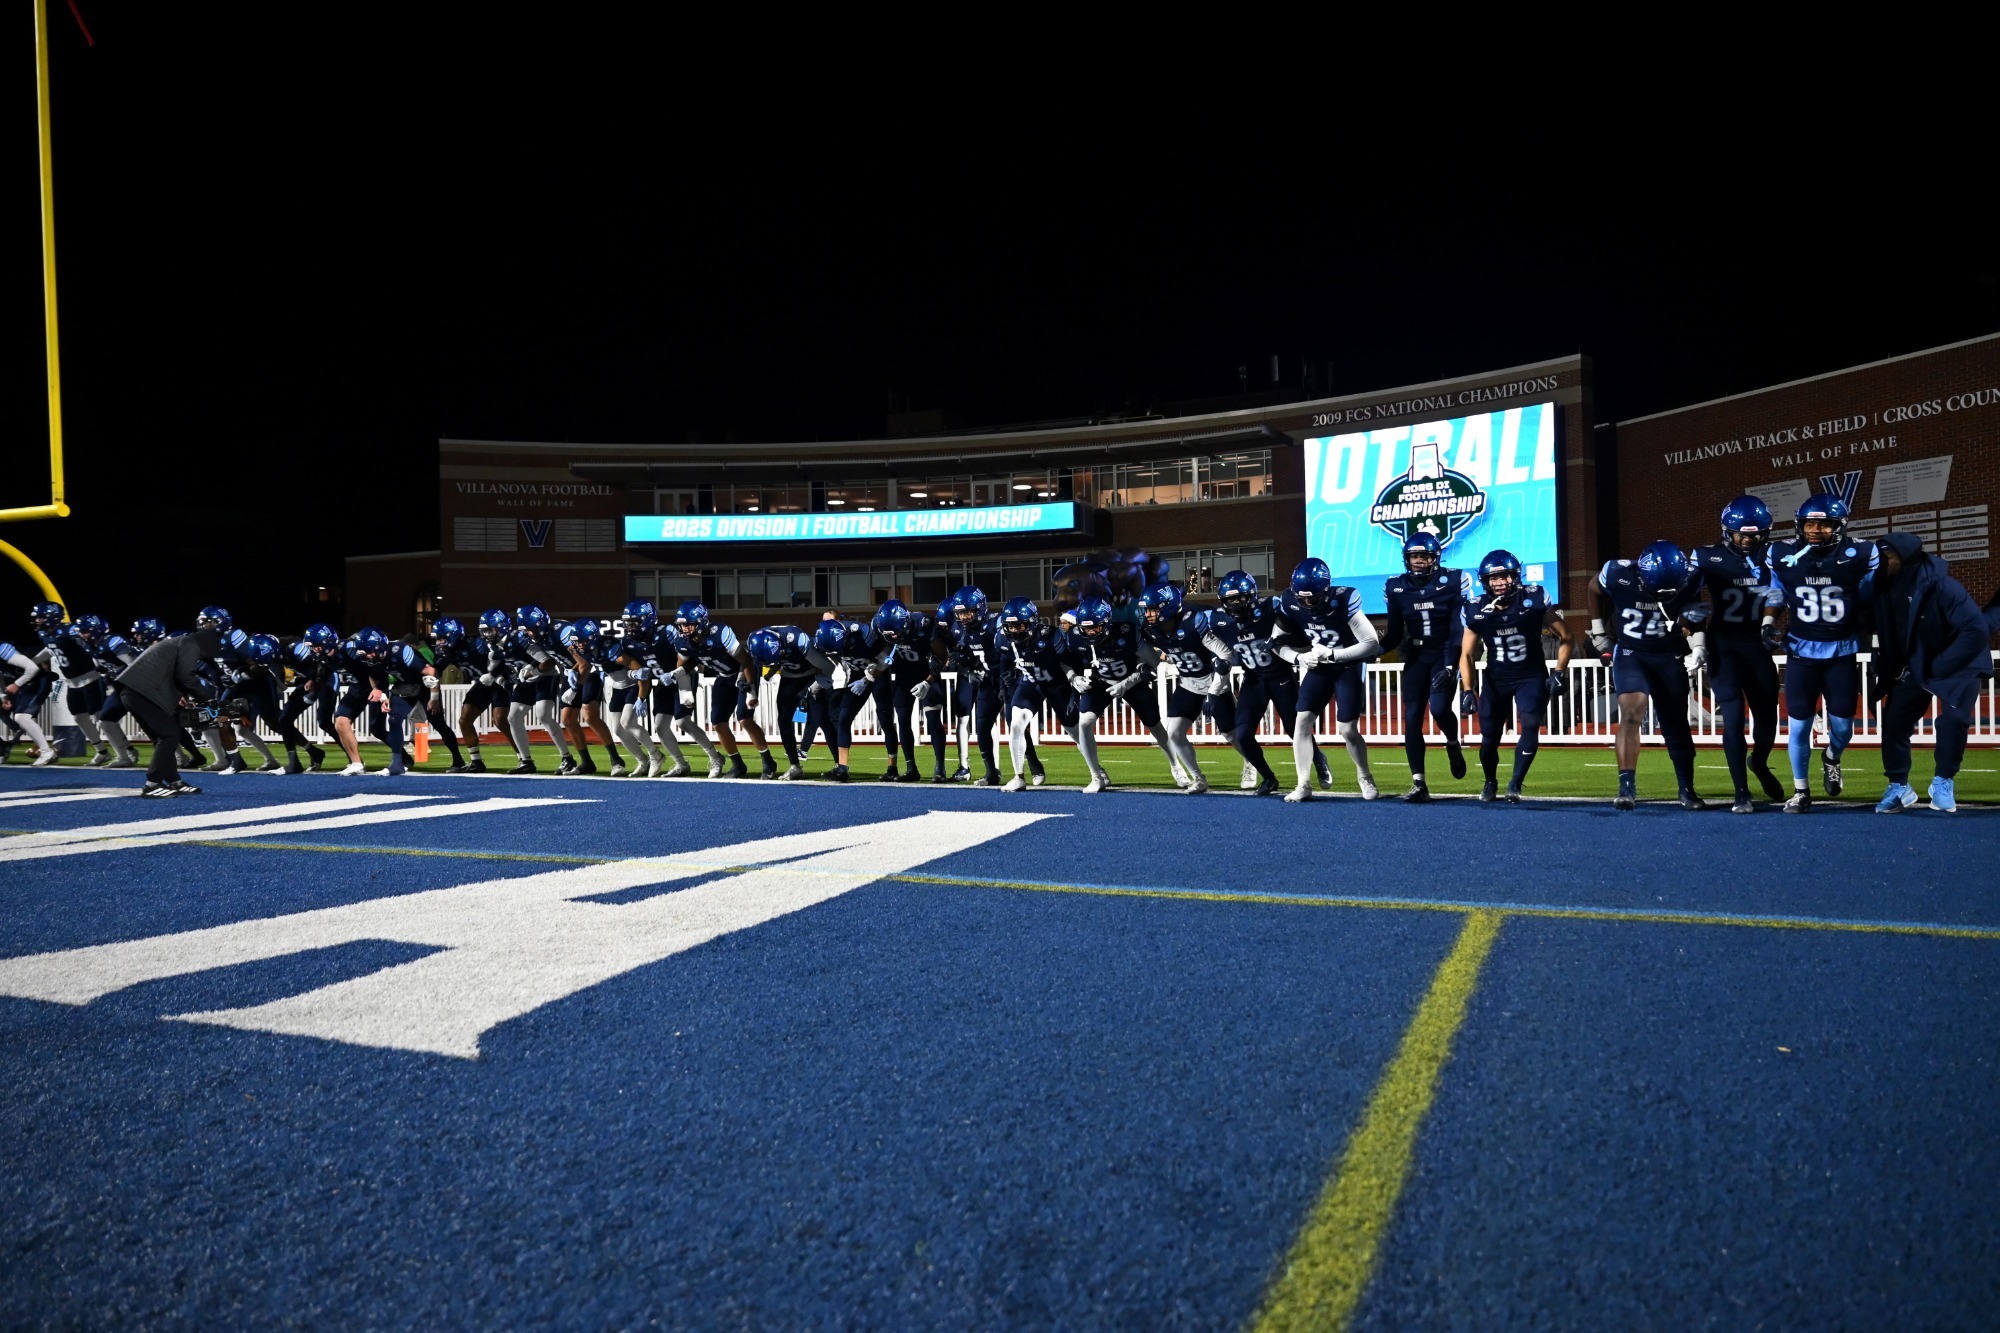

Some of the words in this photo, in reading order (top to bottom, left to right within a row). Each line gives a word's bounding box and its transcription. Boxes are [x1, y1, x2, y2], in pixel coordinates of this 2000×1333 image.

[1312, 412, 1342, 427] 2009
[1346, 406, 1372, 422] FCS
[1375, 394, 1456, 419] NATIONAL
[1458, 375, 1558, 405] CHAMPIONS
[1664, 438, 1743, 467] VILLANOVA
[1745, 426, 1800, 450] TRACK
[1802, 425, 1814, 439] &
[1817, 414, 1867, 437] FIELD
[1883, 399, 1942, 424] CROSS
[1771, 452, 1815, 469] WALL
[1821, 445, 1842, 460] OF
[1850, 436, 1898, 455] FAME
[456, 482, 538, 495] VILLANOVA
[542, 484, 614, 496] FOOTBALL
[1398, 488, 1456, 502] FOOTBALL
[1436, 480, 1450, 489] DI
[497, 499, 526, 507] WALL
[529, 499, 543, 507] OF
[1372, 494, 1483, 522] CHAMPIONSHIP
[661, 518, 712, 538] 2025
[716, 517, 796, 537] DIVISION
[813, 512, 901, 536] FOOTBALL
[904, 507, 1042, 533] CHAMPIONSHIP
[1805, 577, 1832, 585] VILLANOVA
[1413, 601, 1435, 611] VILLANOVA
[1795, 586, 1845, 623] 36
[1420, 610, 1432, 636] 1
[1496, 626, 1519, 636] VILLANOVA
[1621, 607, 1667, 640] 24
[973, 650, 990, 671] 7
